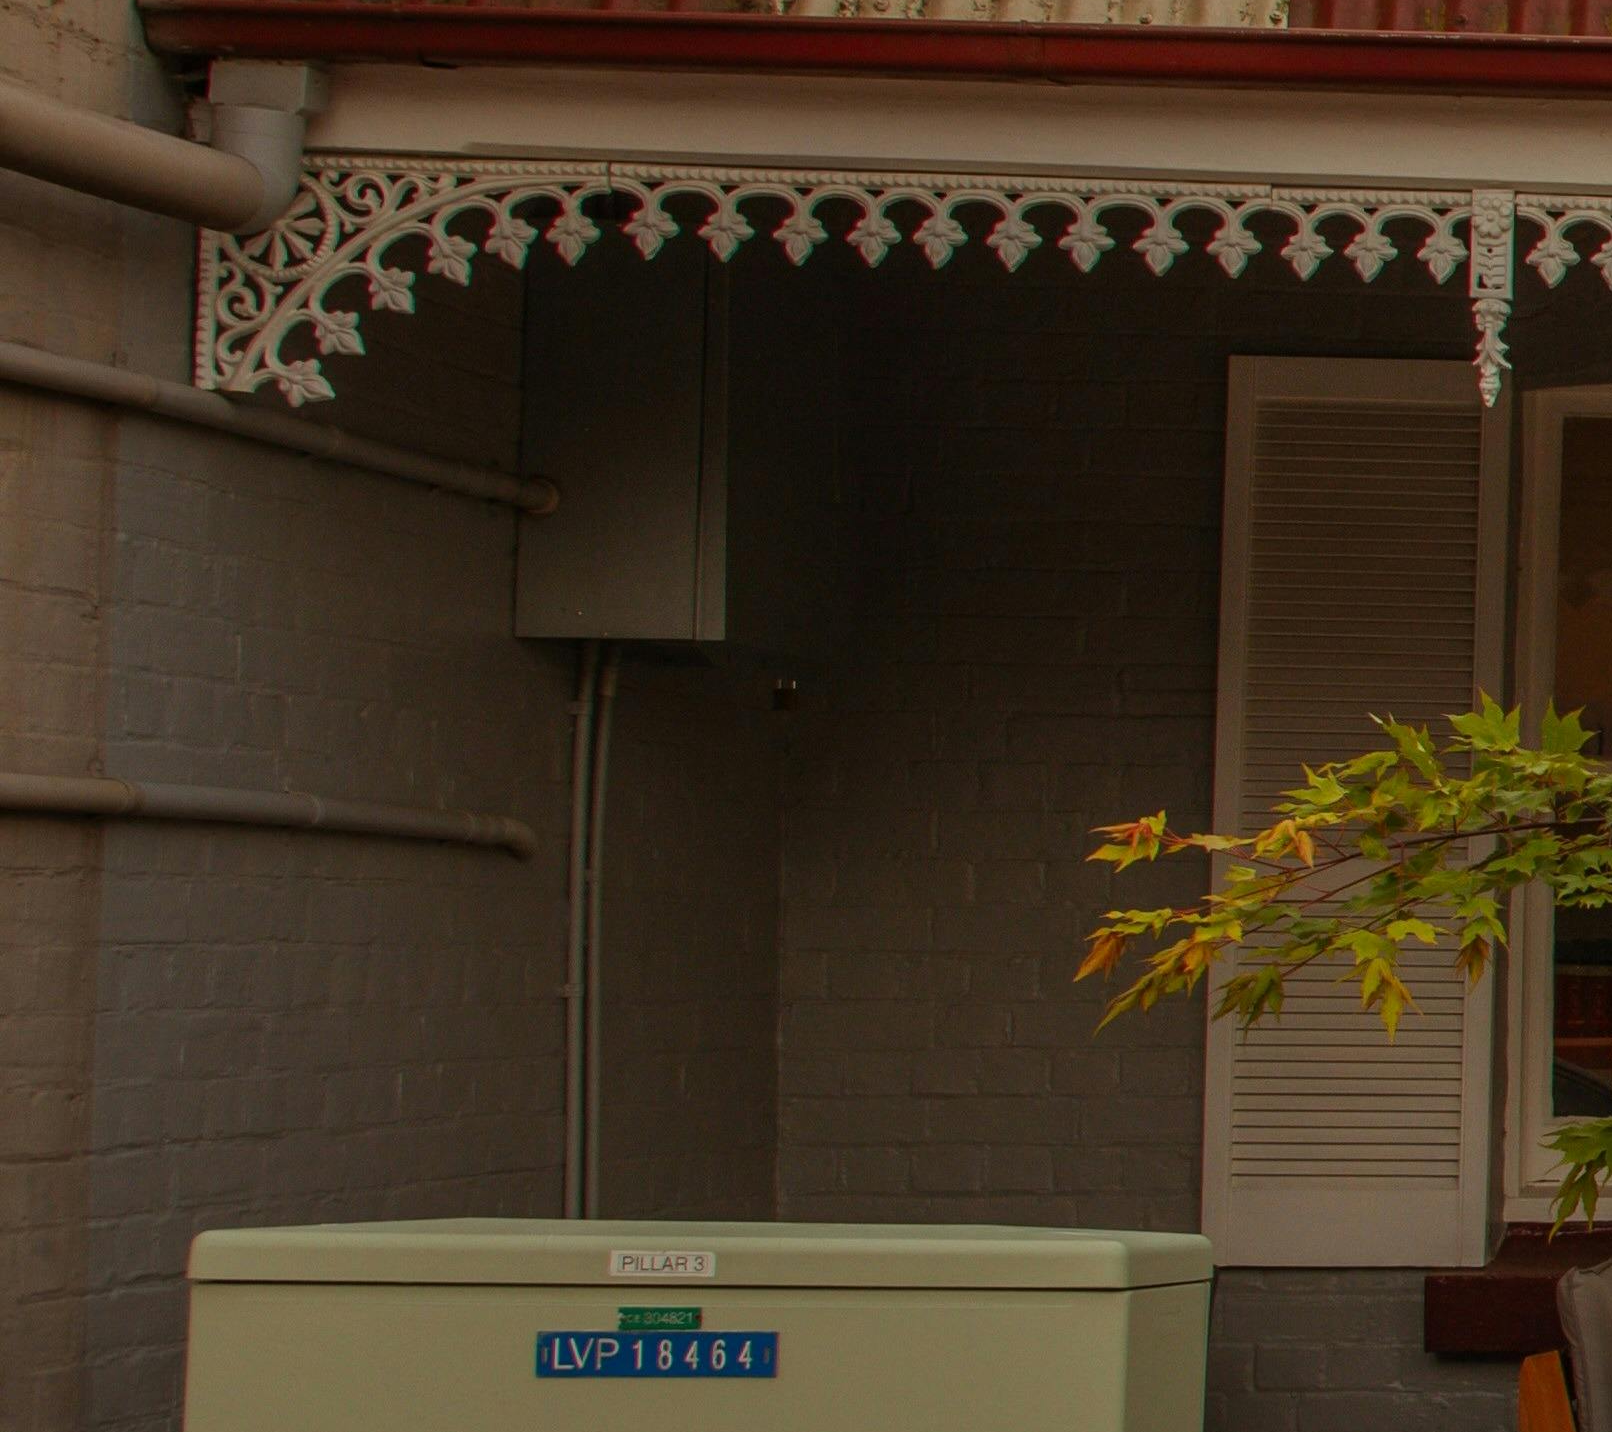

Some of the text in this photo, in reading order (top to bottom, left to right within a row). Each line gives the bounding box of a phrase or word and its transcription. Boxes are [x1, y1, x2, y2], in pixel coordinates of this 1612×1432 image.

[622, 1255, 705, 1271] PILLAR 3
[552, 1336, 753, 1371] LVP 18464
